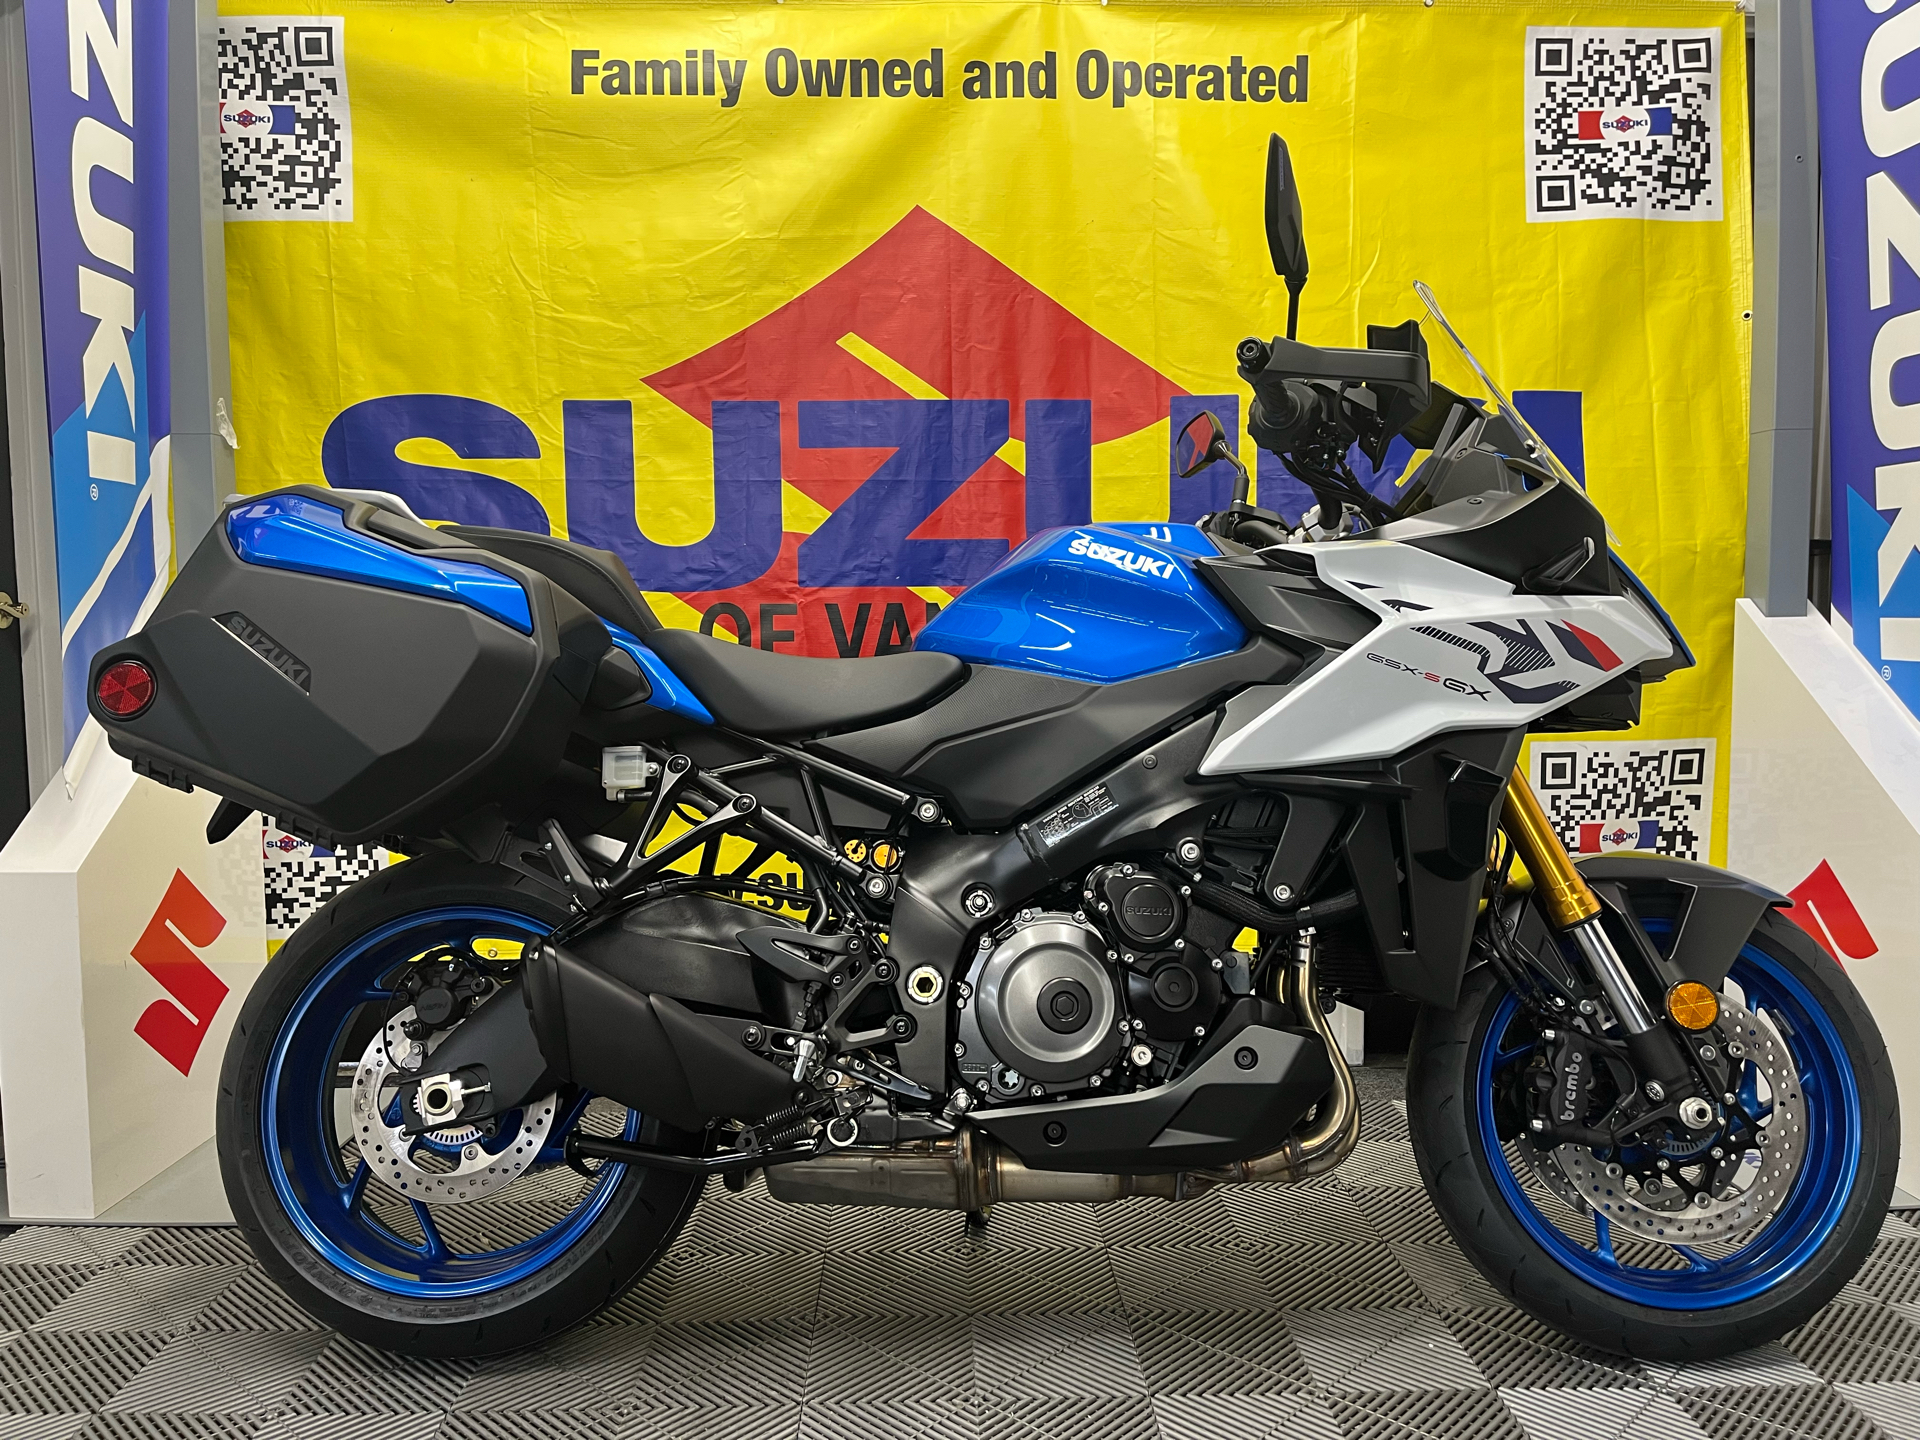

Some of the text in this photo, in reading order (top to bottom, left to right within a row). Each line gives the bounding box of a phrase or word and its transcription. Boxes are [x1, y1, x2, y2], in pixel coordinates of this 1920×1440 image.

[570, 47, 1309, 108] Family Owned and Operated
[223, 114, 271, 124] SUZUKI
[1602, 119, 1648, 129] SUZUKI
[1861, 0, 1920, 662] UZUKI
[1068, 537, 1175, 580] SUZUKI
[226, 616, 310, 685] SUZUKI
[824, 602, 945, 659] VA
[1601, 831, 1638, 842] SUZUKI
[1126, 906, 1172, 916] SUZUKI
[1560, 1052, 1582, 1121] brembo
